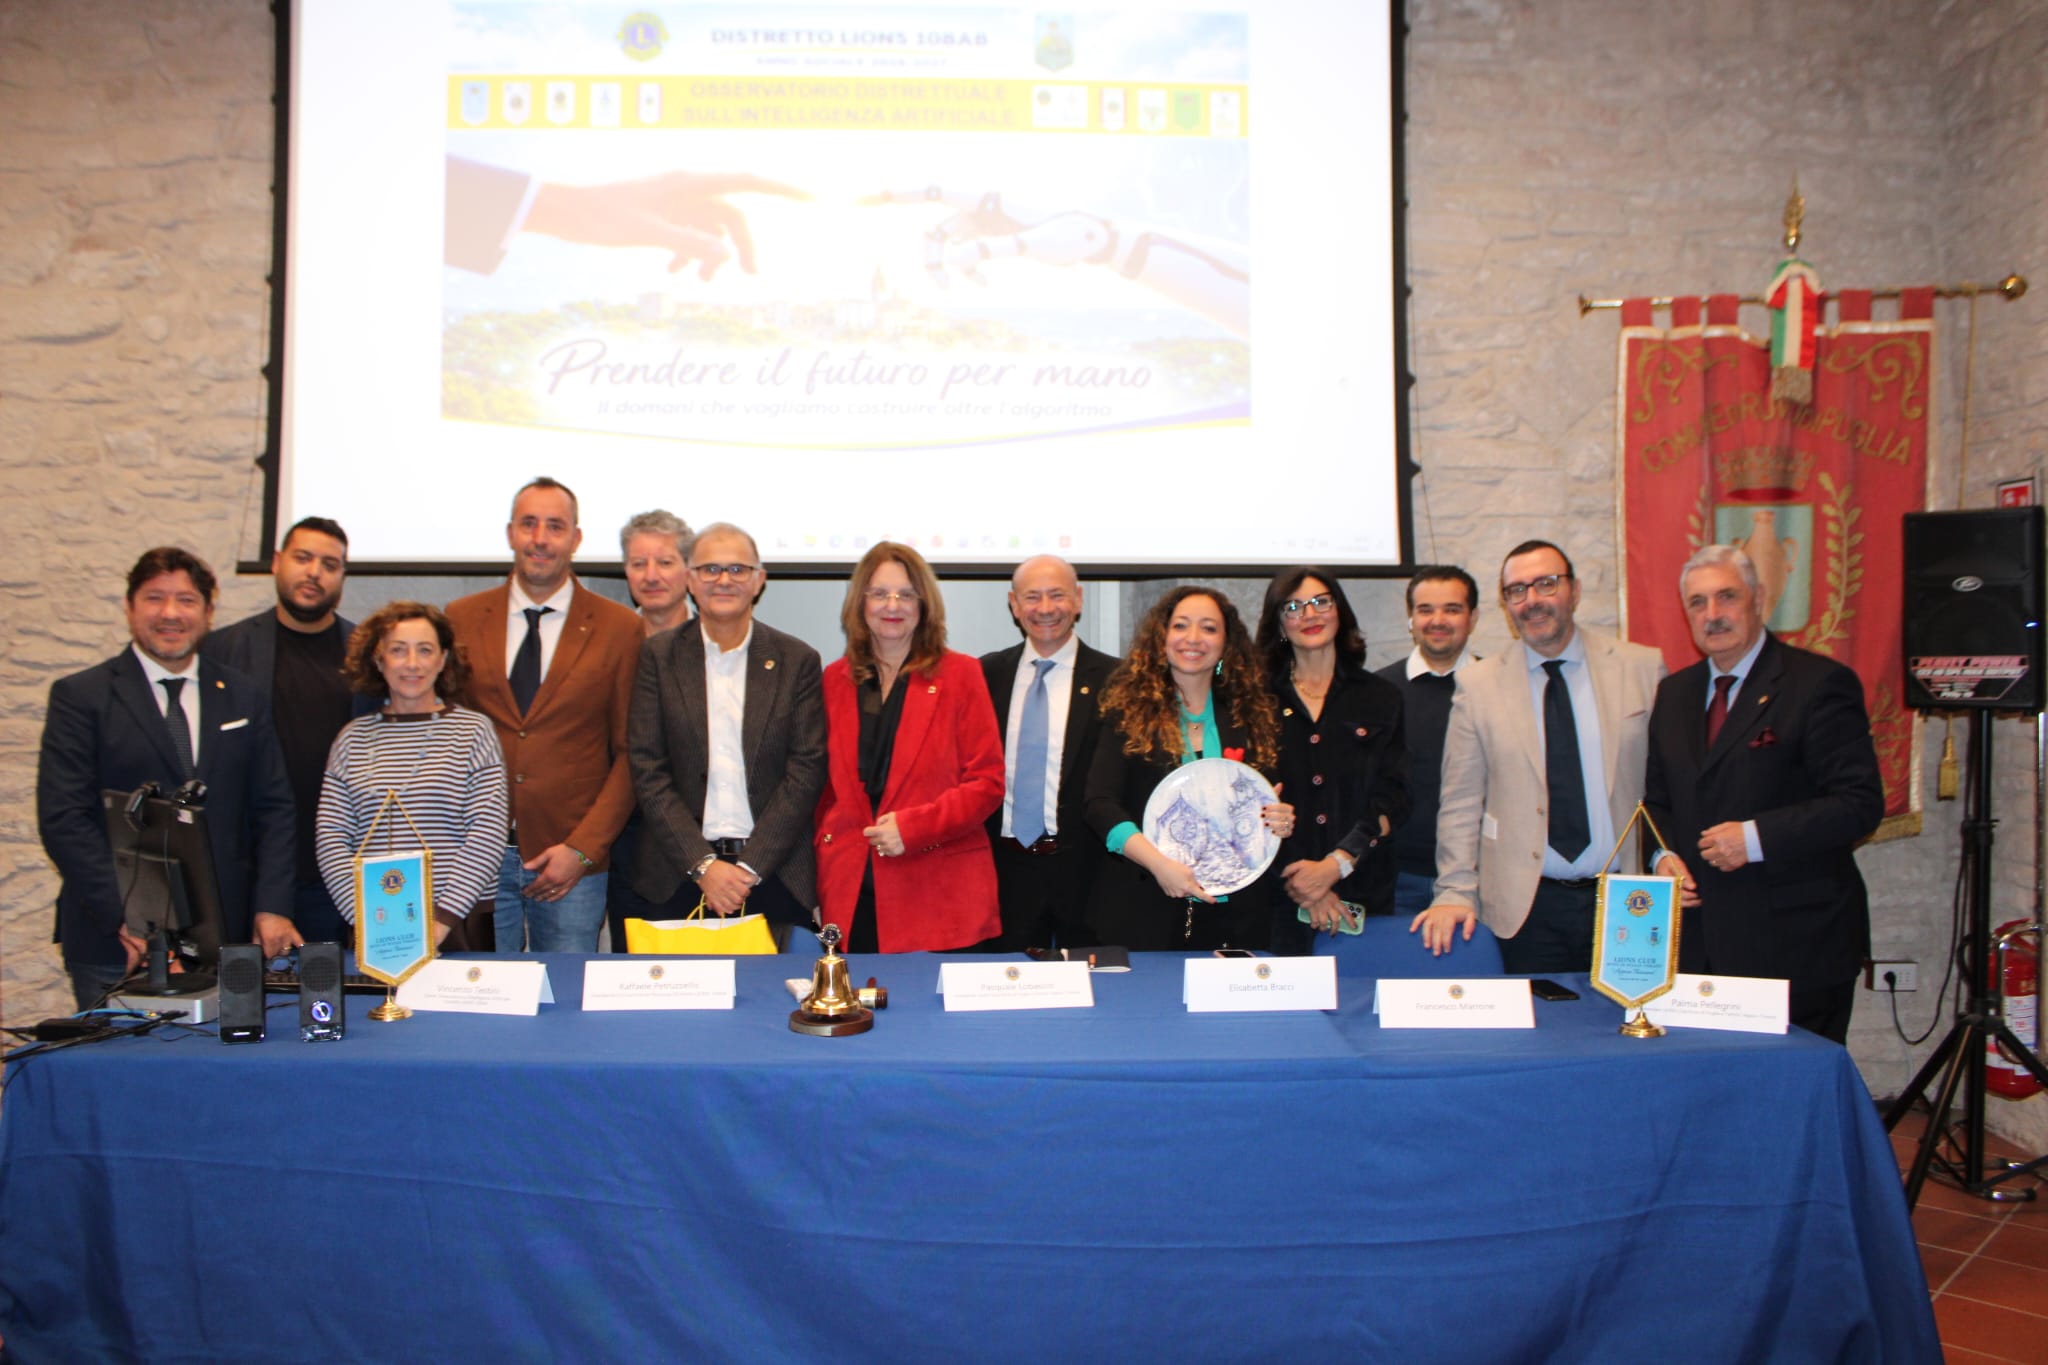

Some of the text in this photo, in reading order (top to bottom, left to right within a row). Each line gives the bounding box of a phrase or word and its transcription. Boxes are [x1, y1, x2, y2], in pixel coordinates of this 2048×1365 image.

[711, 29, 989, 47] DISTRETTO LIONS 108AB
[690, 82, 1008, 102] OSSERVATORIO DISTRETTUALE
[683, 106, 1014, 126] SULL'INTELLIGENZA ARTIFICIALE
[539, 338, 1152, 401] Prendere il futuro per mano
[597, 399, 1113, 420] Il domani che vogliamo costruire oltre l'algoritmo
[1818, 406, 1911, 466] PUGLIA
[1229, 983, 1268, 992] Elisabetta
[1415, 1002, 1457, 1011] Francesco
